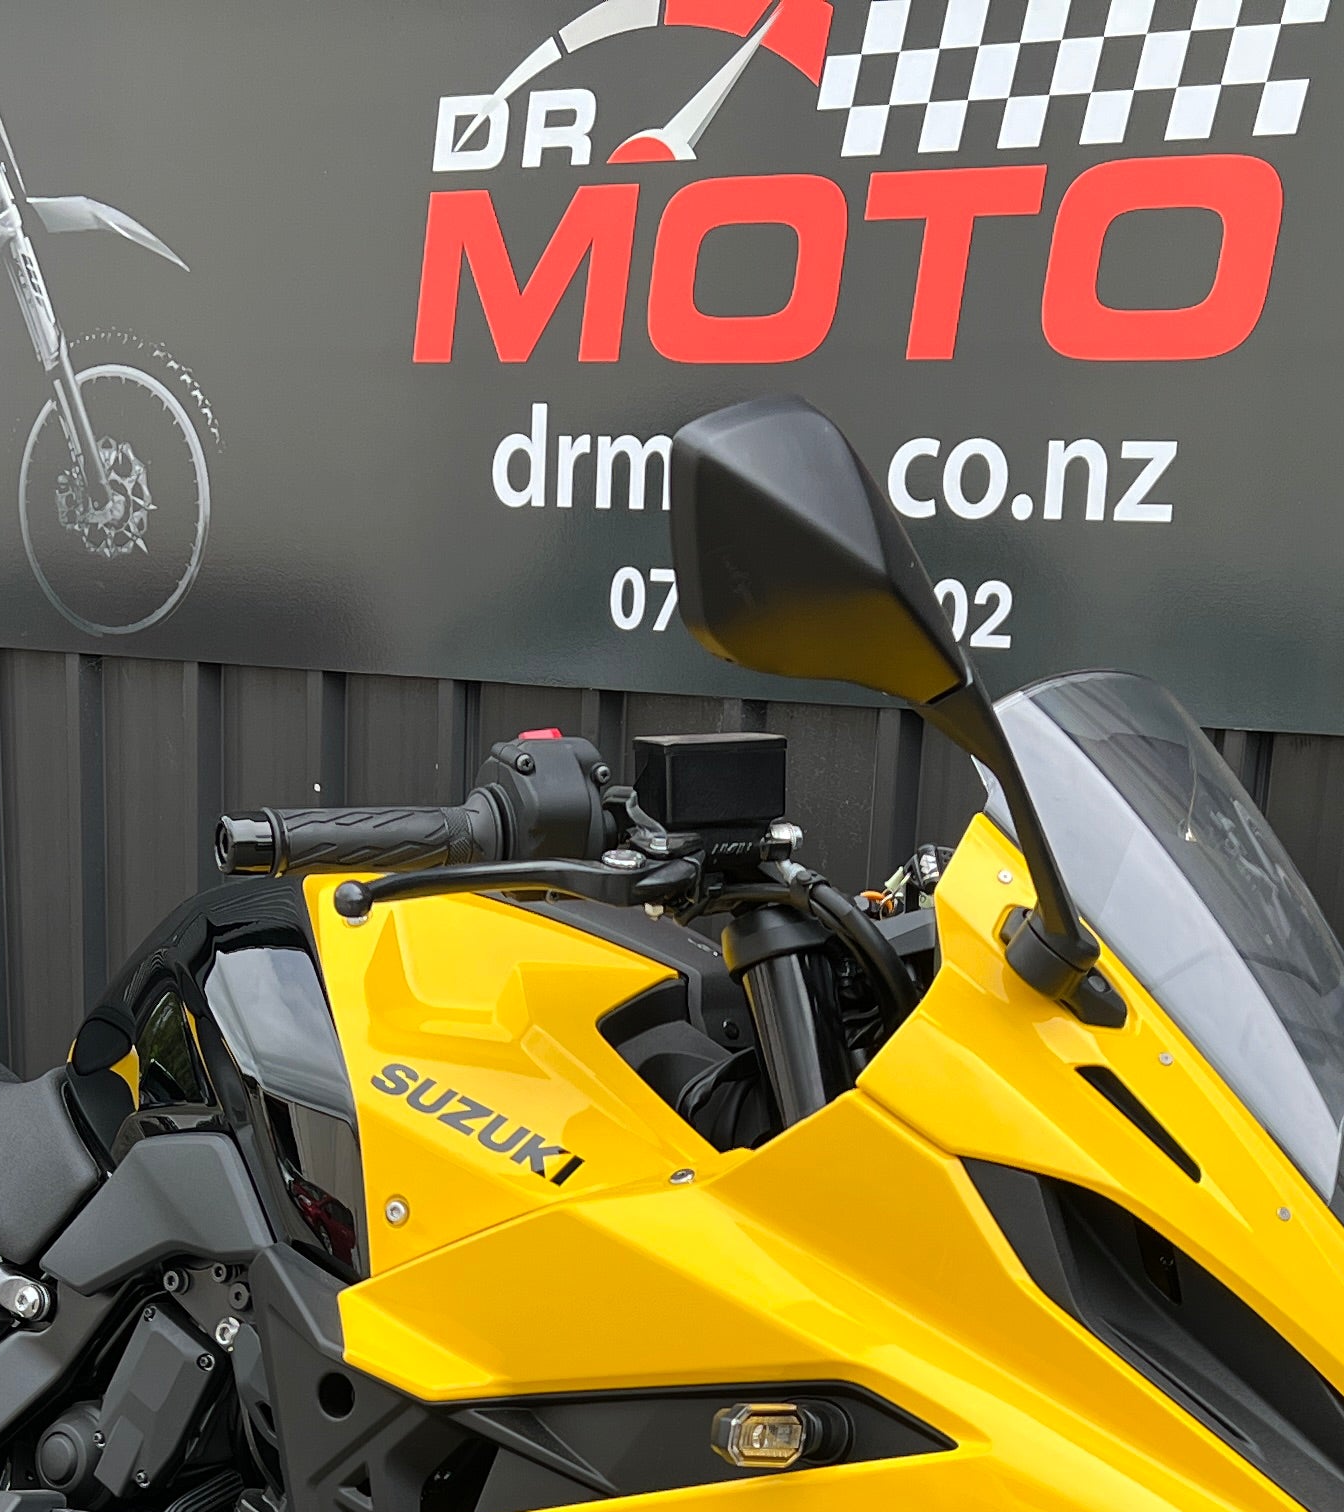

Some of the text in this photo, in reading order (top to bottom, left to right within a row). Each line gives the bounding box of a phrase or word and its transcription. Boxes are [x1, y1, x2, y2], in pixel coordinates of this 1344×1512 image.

[432, 88, 598, 173] DR
[412, 153, 1284, 364] MOTO
[492, 403, 1179, 523] drmco.nz
[610, 566, 1013, 650] 07 02
[371, 1062, 584, 1187] SUZUKI
